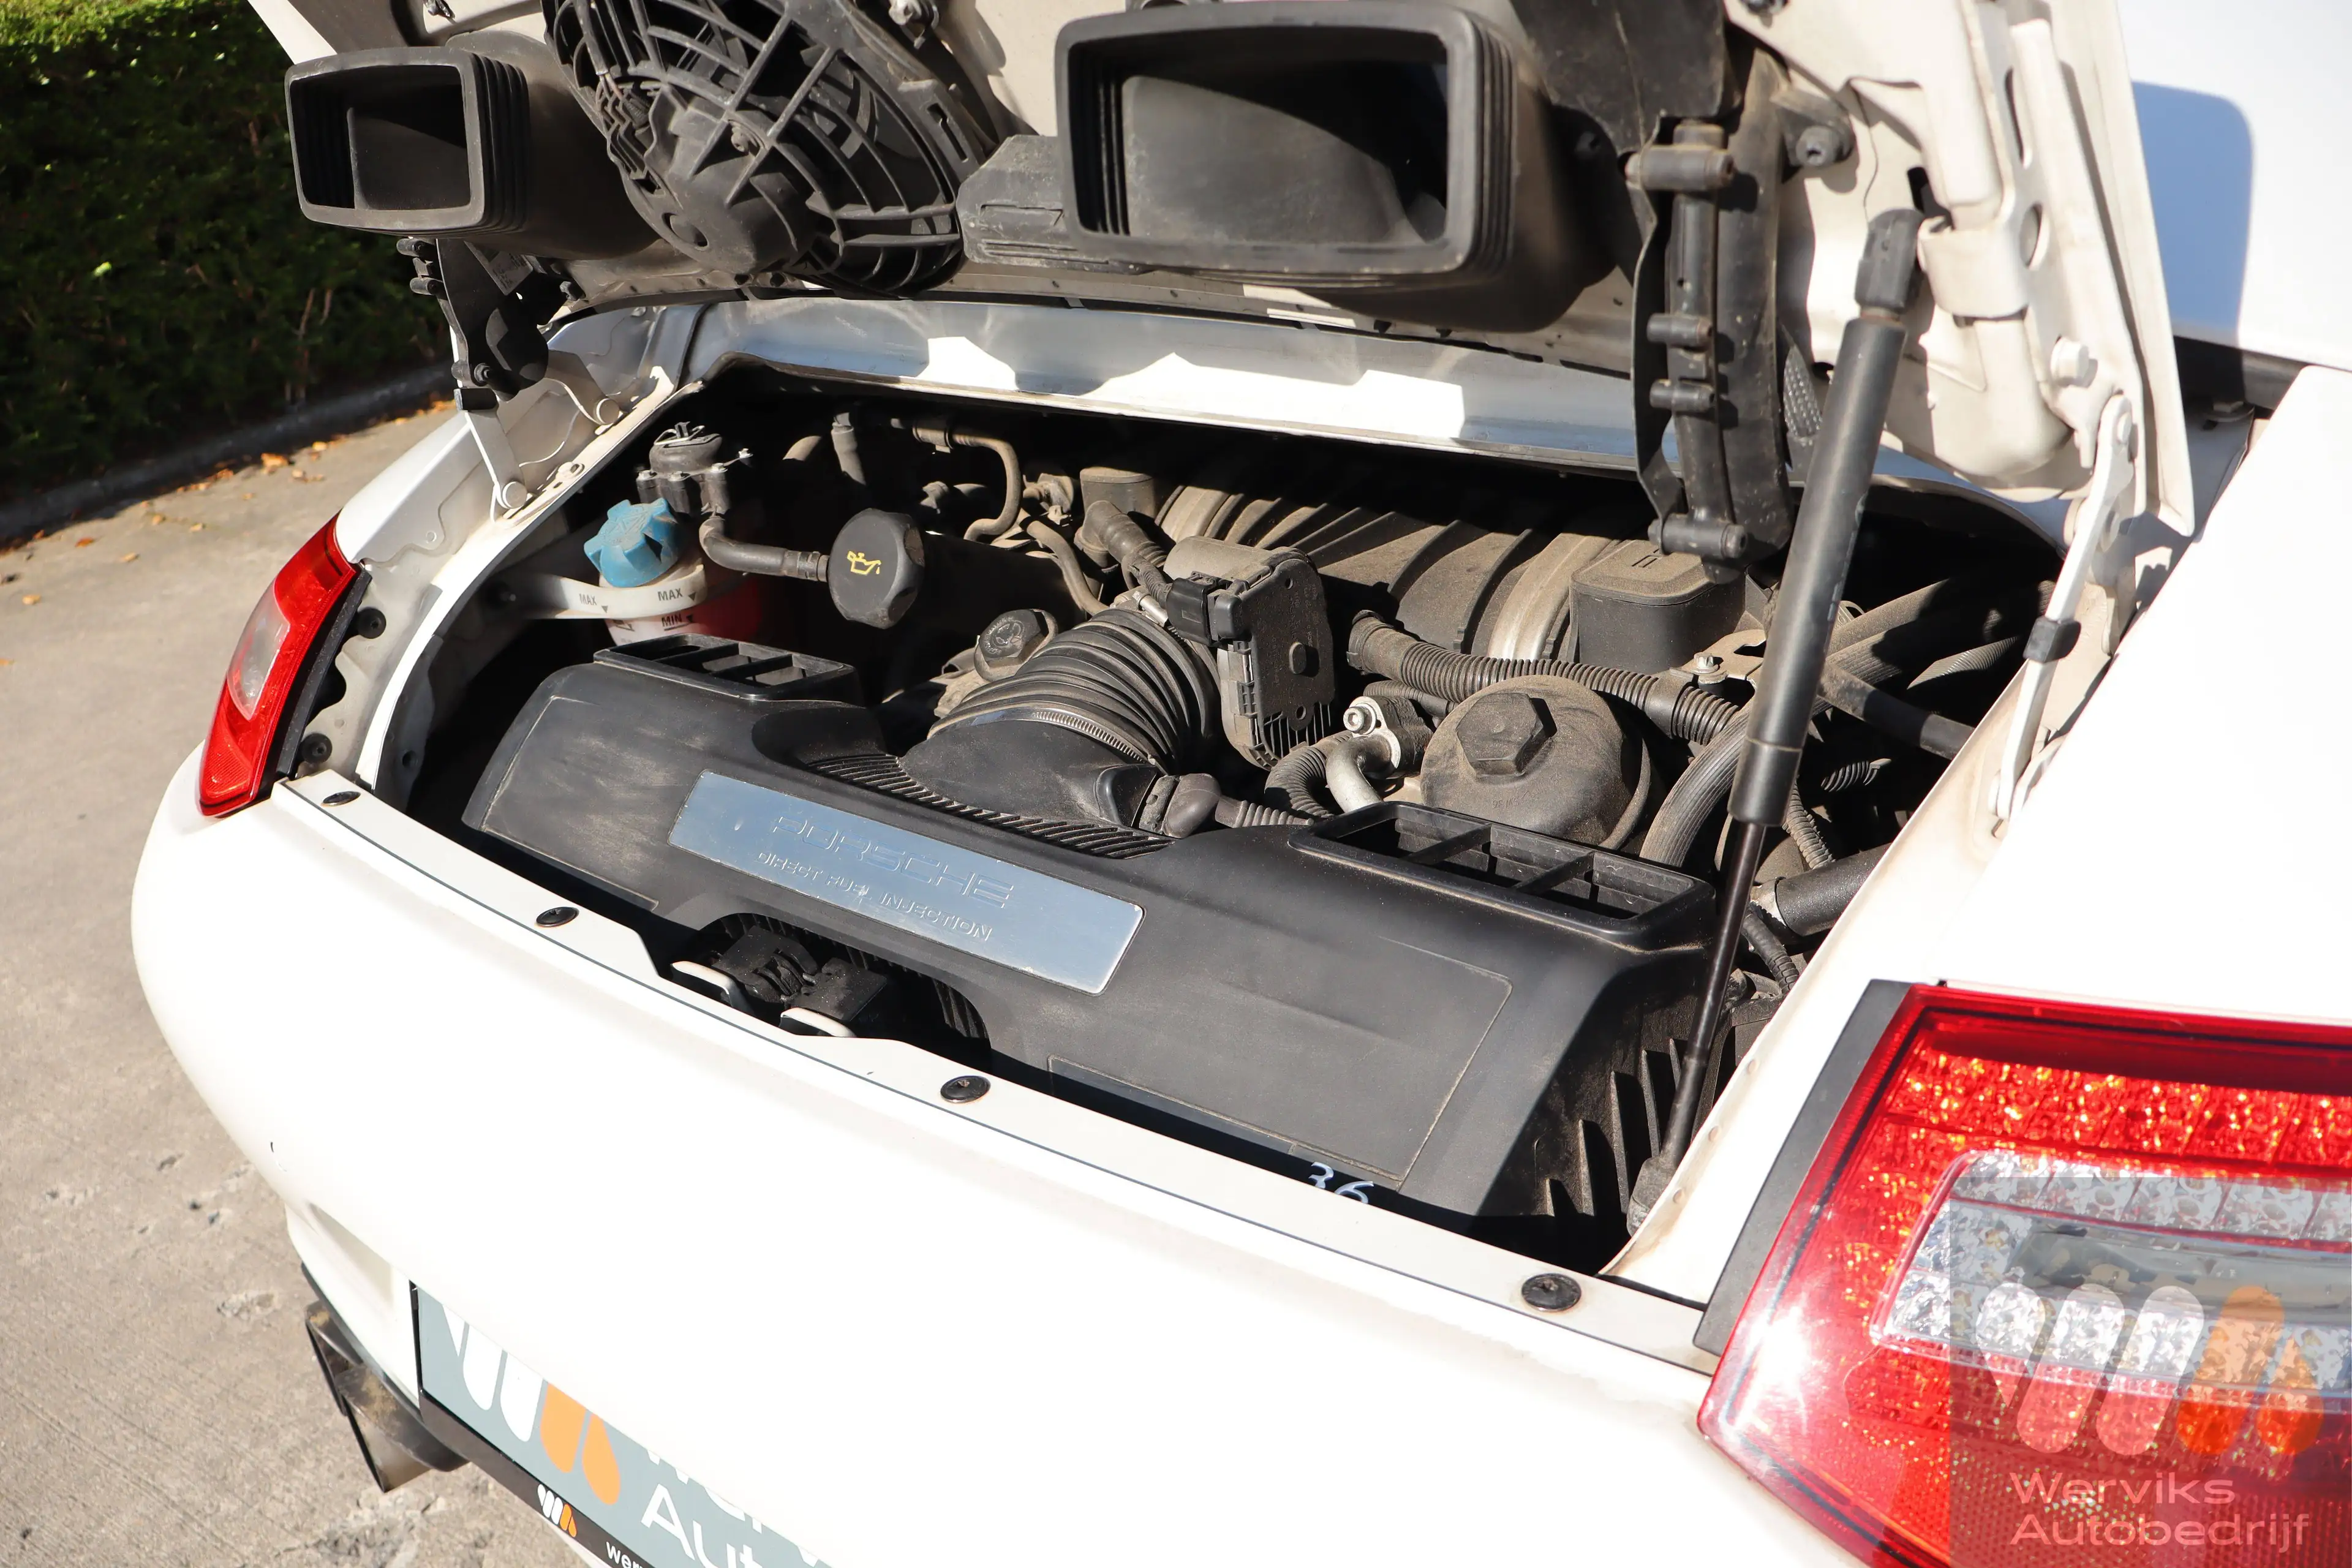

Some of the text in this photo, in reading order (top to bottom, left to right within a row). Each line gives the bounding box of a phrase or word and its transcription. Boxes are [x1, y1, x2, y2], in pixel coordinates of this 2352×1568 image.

[579, 593, 597, 606] MAX
[657, 587, 684, 601] MAX
[661, 613, 683, 627] MIN
[772, 815, 1014, 909] PORSCHE
[758, 852, 993, 941] DIRECT FUEL INJECTION
